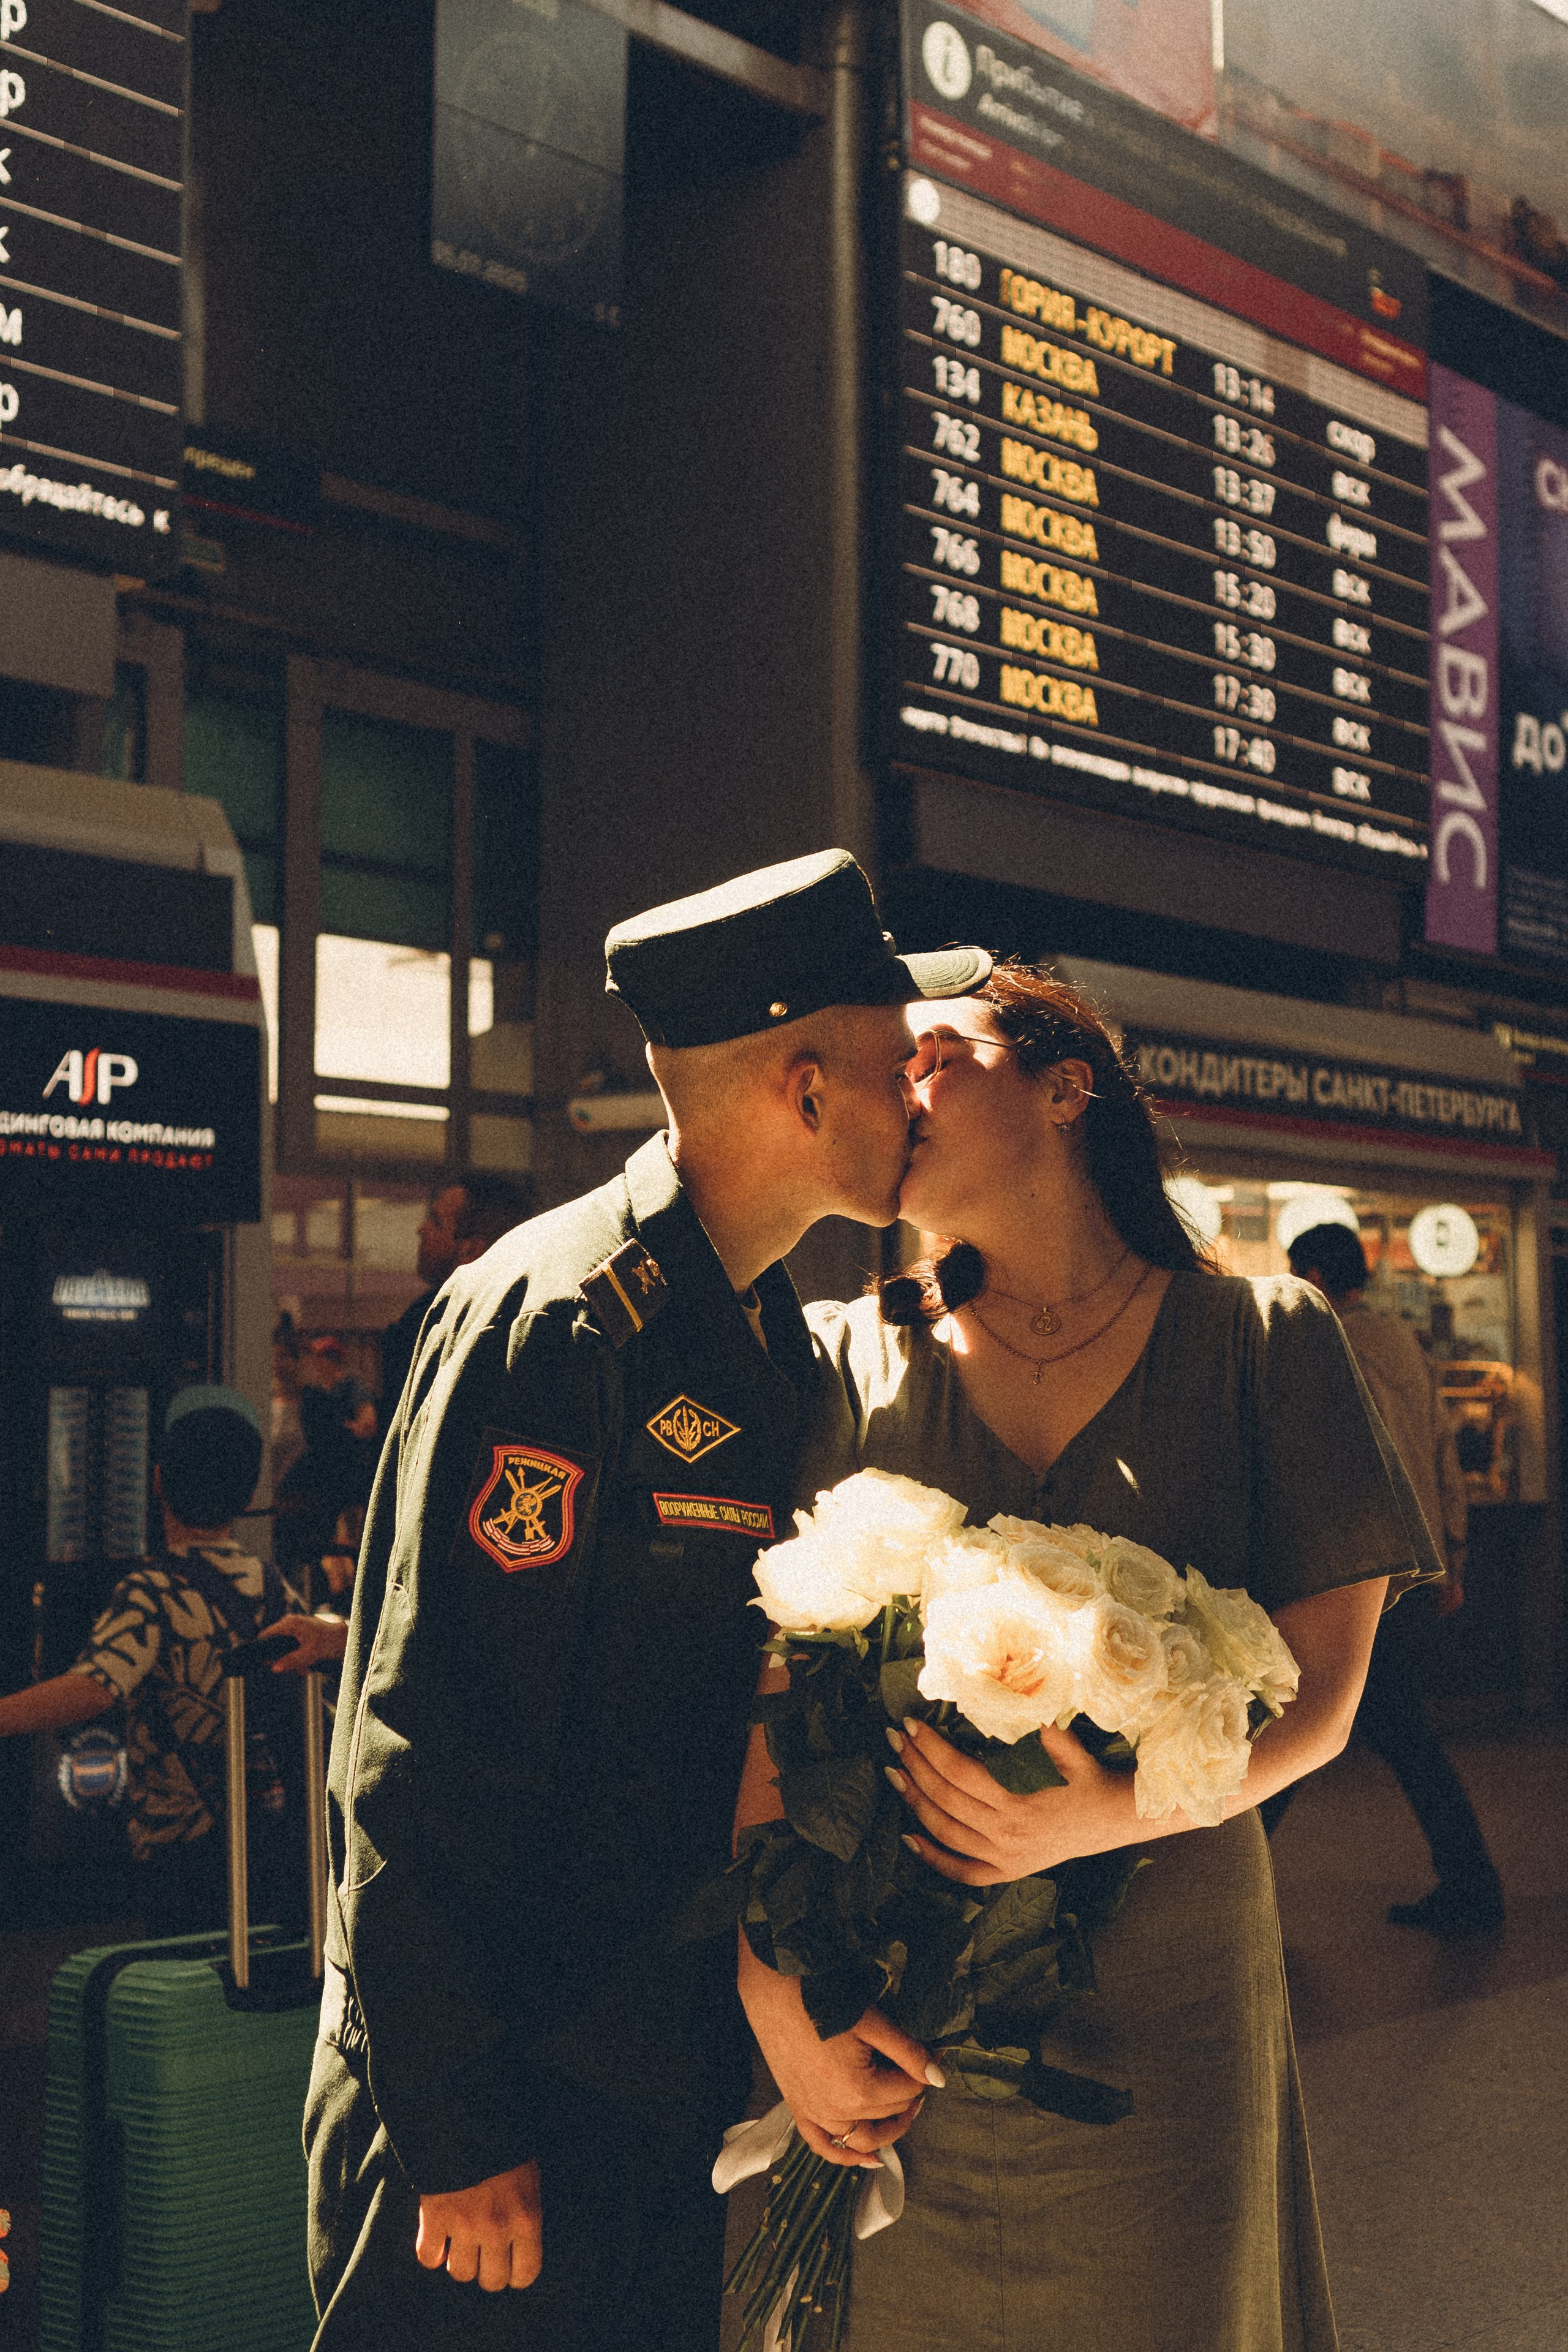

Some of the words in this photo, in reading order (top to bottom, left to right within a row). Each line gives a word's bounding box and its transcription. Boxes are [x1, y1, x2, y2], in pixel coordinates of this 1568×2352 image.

[933, 241, 981, 289] 180
[932, 296, 981, 345] 760
[1001, 325, 1099, 396] МОСКВА
[933, 356, 981, 402] 134
[932, 412, 980, 461] 762
[1001, 437, 1099, 507] МОСКВА
[932, 469, 980, 516] 764
[1001, 494, 1099, 561] МОСКВА
[932, 527, 980, 575] 766
[1001, 550, 1099, 616] МОСКВА
[931, 585, 980, 632] 768
[1000, 606, 1099, 671] МОСКВА
[1437, 424, 1488, 890] МАВИС
[931, 643, 980, 689] 770
[1000, 664, 1099, 726] МОСКВА
[1139, 1044, 1308, 1101] КОНДИТЕРЫ
[1313, 1069, 1523, 1133] САНКТ-ПЕТЕРБУРГА
[107, 1120, 216, 1149] КОМПАНИЯ
[508, 1457, 567, 1480] РЕЖИЦКАЯ
[658, 1501, 720, 1520] ВООРУЖЕННЫЕ
[719, 1506, 741, 1523] СИЛЫ
[741, 1510, 769, 1529] РОССИИ
